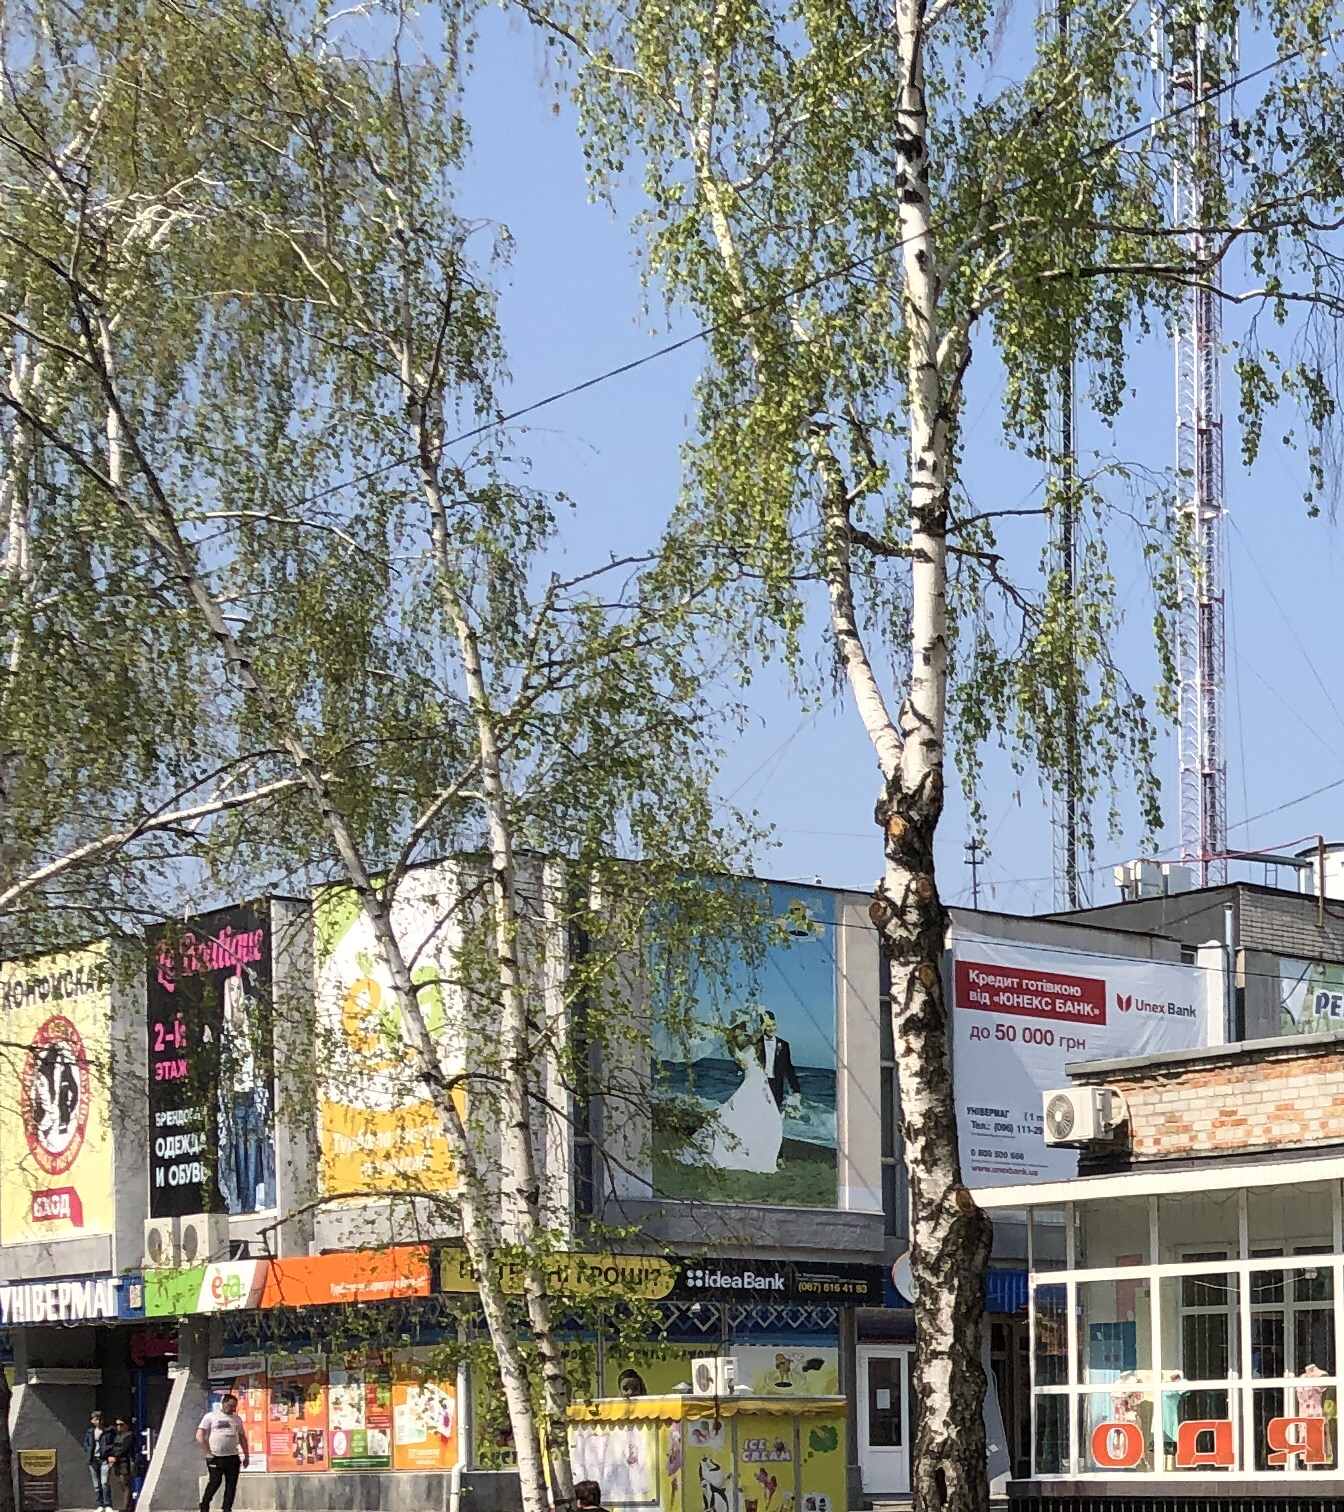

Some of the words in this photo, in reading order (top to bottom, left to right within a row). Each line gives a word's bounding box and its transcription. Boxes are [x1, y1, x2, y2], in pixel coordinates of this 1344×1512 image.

[968, 969, 1020, 989] Кредит
[1021, 978, 1082, 998] готівкою
[969, 990, 990, 1005] від
[992, 991, 1053, 1012] «ЮНЕКС
[1055, 998, 1101, 1018] БАНК»
[1135, 998, 1166, 1014] Unex
[1167, 1002, 1197, 1019] Bank
[969, 1025, 992, 1042] до
[994, 1023, 1017, 1042] 50
[1021, 1026, 1055, 1048] 000
[1058, 1036, 1087, 1053] грн
[154, 1059, 188, 1081] ЭТАЖ
[154, 1105, 209, 1127] БРЕНДО
[966, 1106, 1010, 1119] УНІВЕРМАГ
[155, 1131, 208, 1160] ОДЕЖДА
[155, 1166, 165, 1188] И
[0, 1278, 121, 1323] УНІВЕРМАГ
[743, 1439, 767, 1450] ICE
[741, 1450, 792, 1462] CREAM
